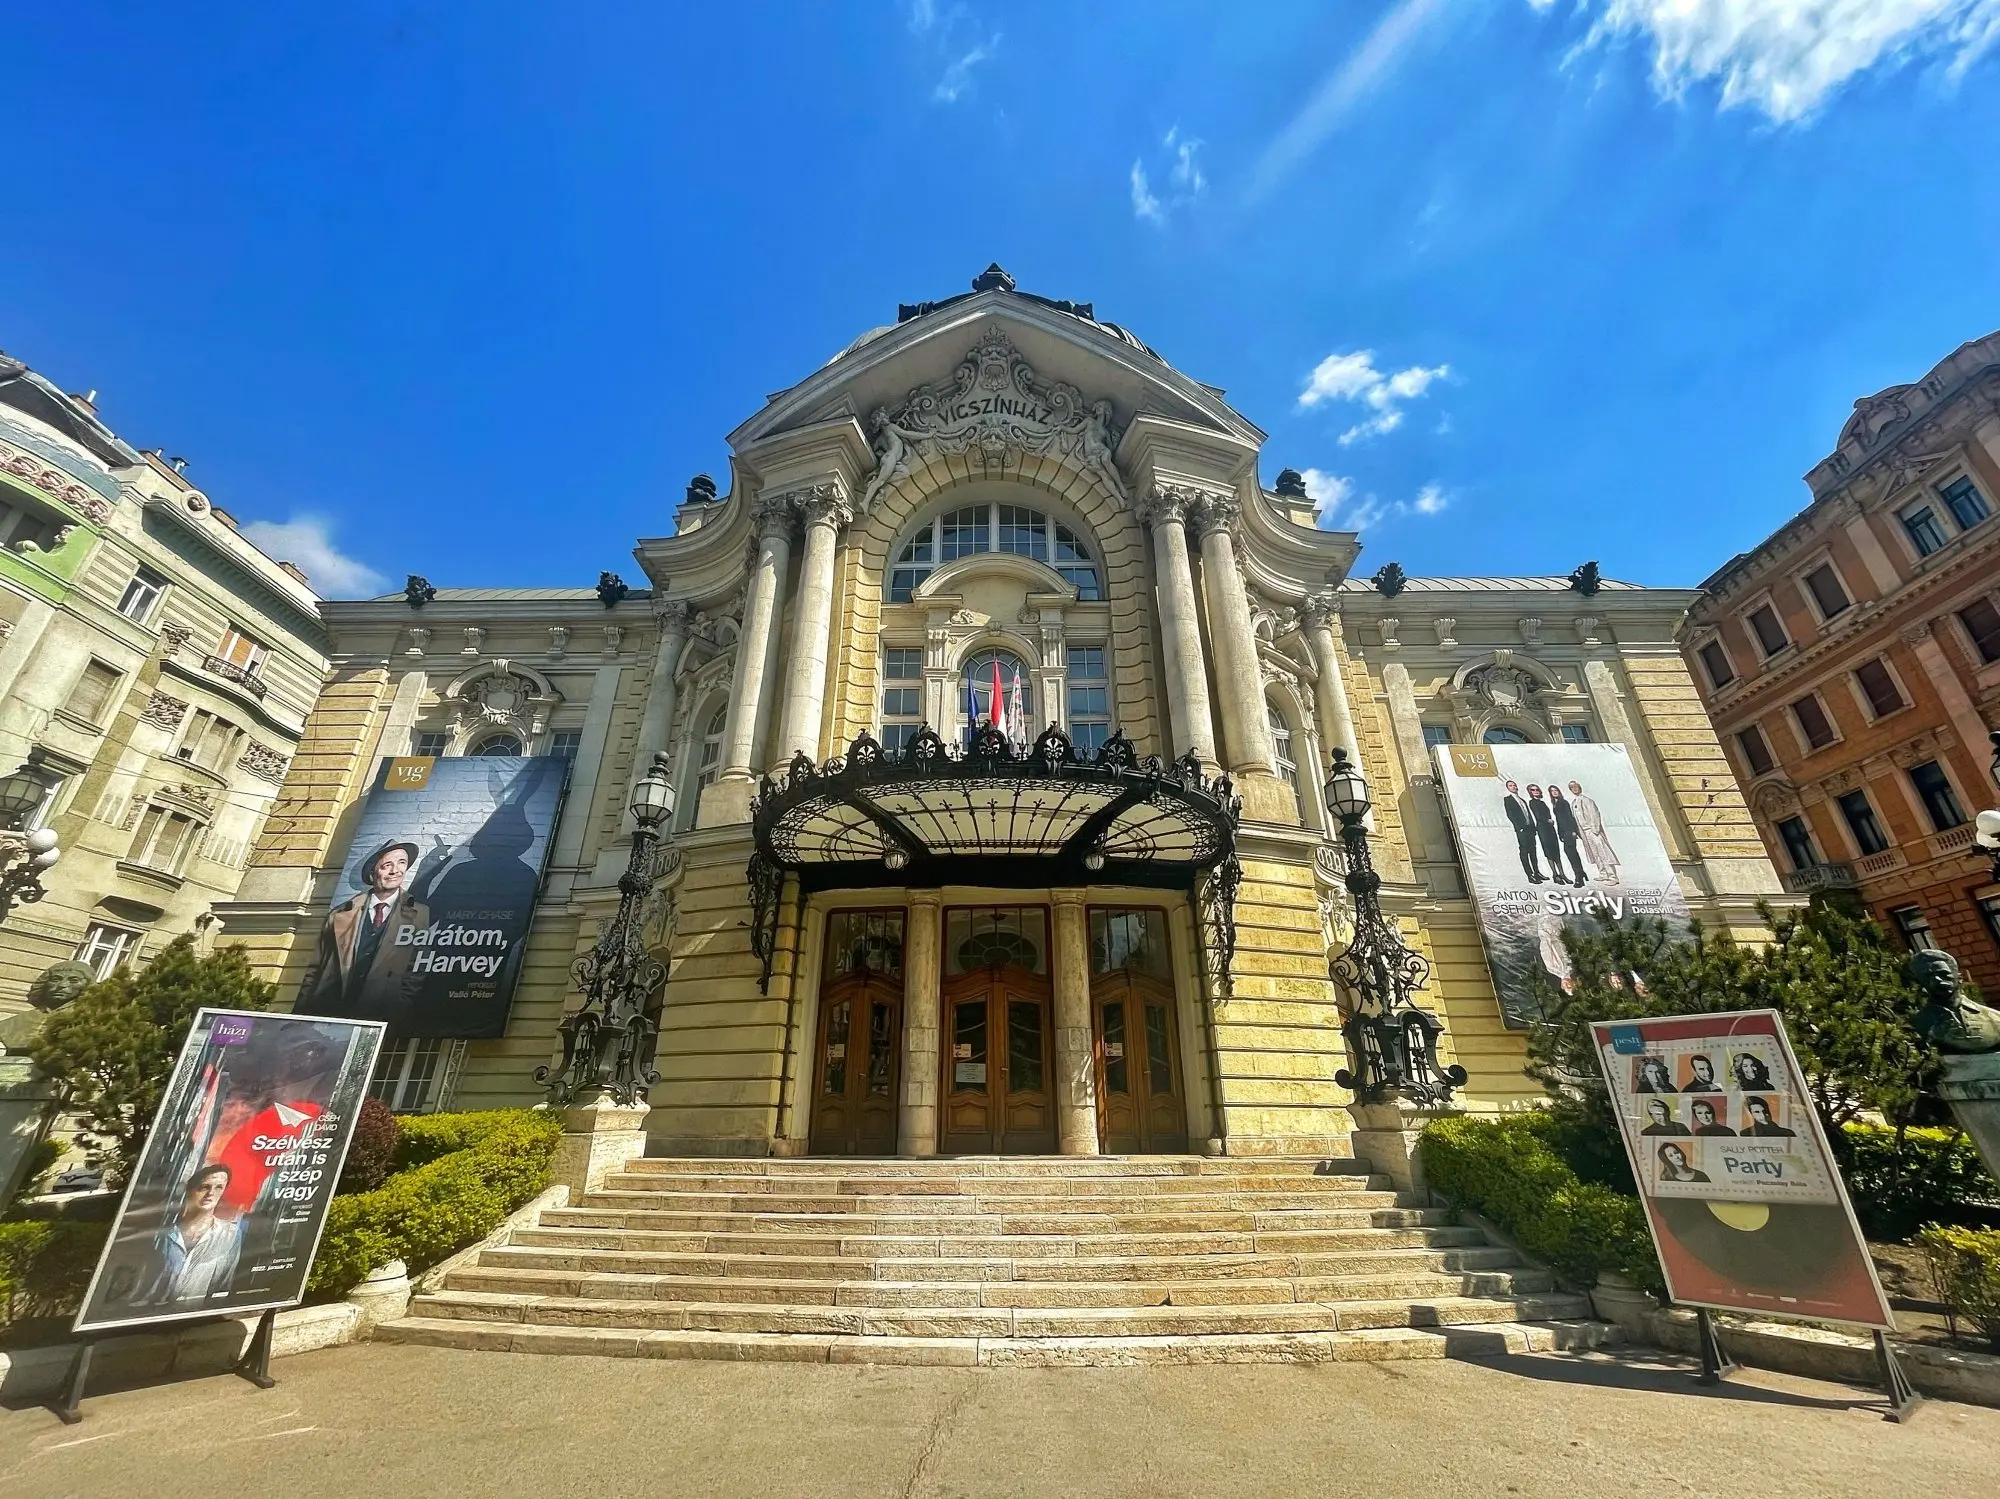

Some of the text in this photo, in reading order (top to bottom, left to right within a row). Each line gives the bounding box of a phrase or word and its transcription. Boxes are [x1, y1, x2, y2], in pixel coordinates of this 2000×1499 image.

[1496, 890, 1538, 901] ANTON
[1492, 904, 1541, 915] CSEHOV
[1543, 889, 1623, 920] Sirály
[478, 910, 515, 920] CHASE
[394, 923, 508, 950] Barátom,
[412, 950, 504, 978] Harvey
[251, 1135, 334, 1151] Szélvész
[1748, 1146, 1785, 1154] POTTER
[264, 1149, 328, 1167] után is
[277, 1166, 323, 1185] szép
[1723, 1156, 1783, 1178] Party
[274, 1185, 320, 1202] vagy
